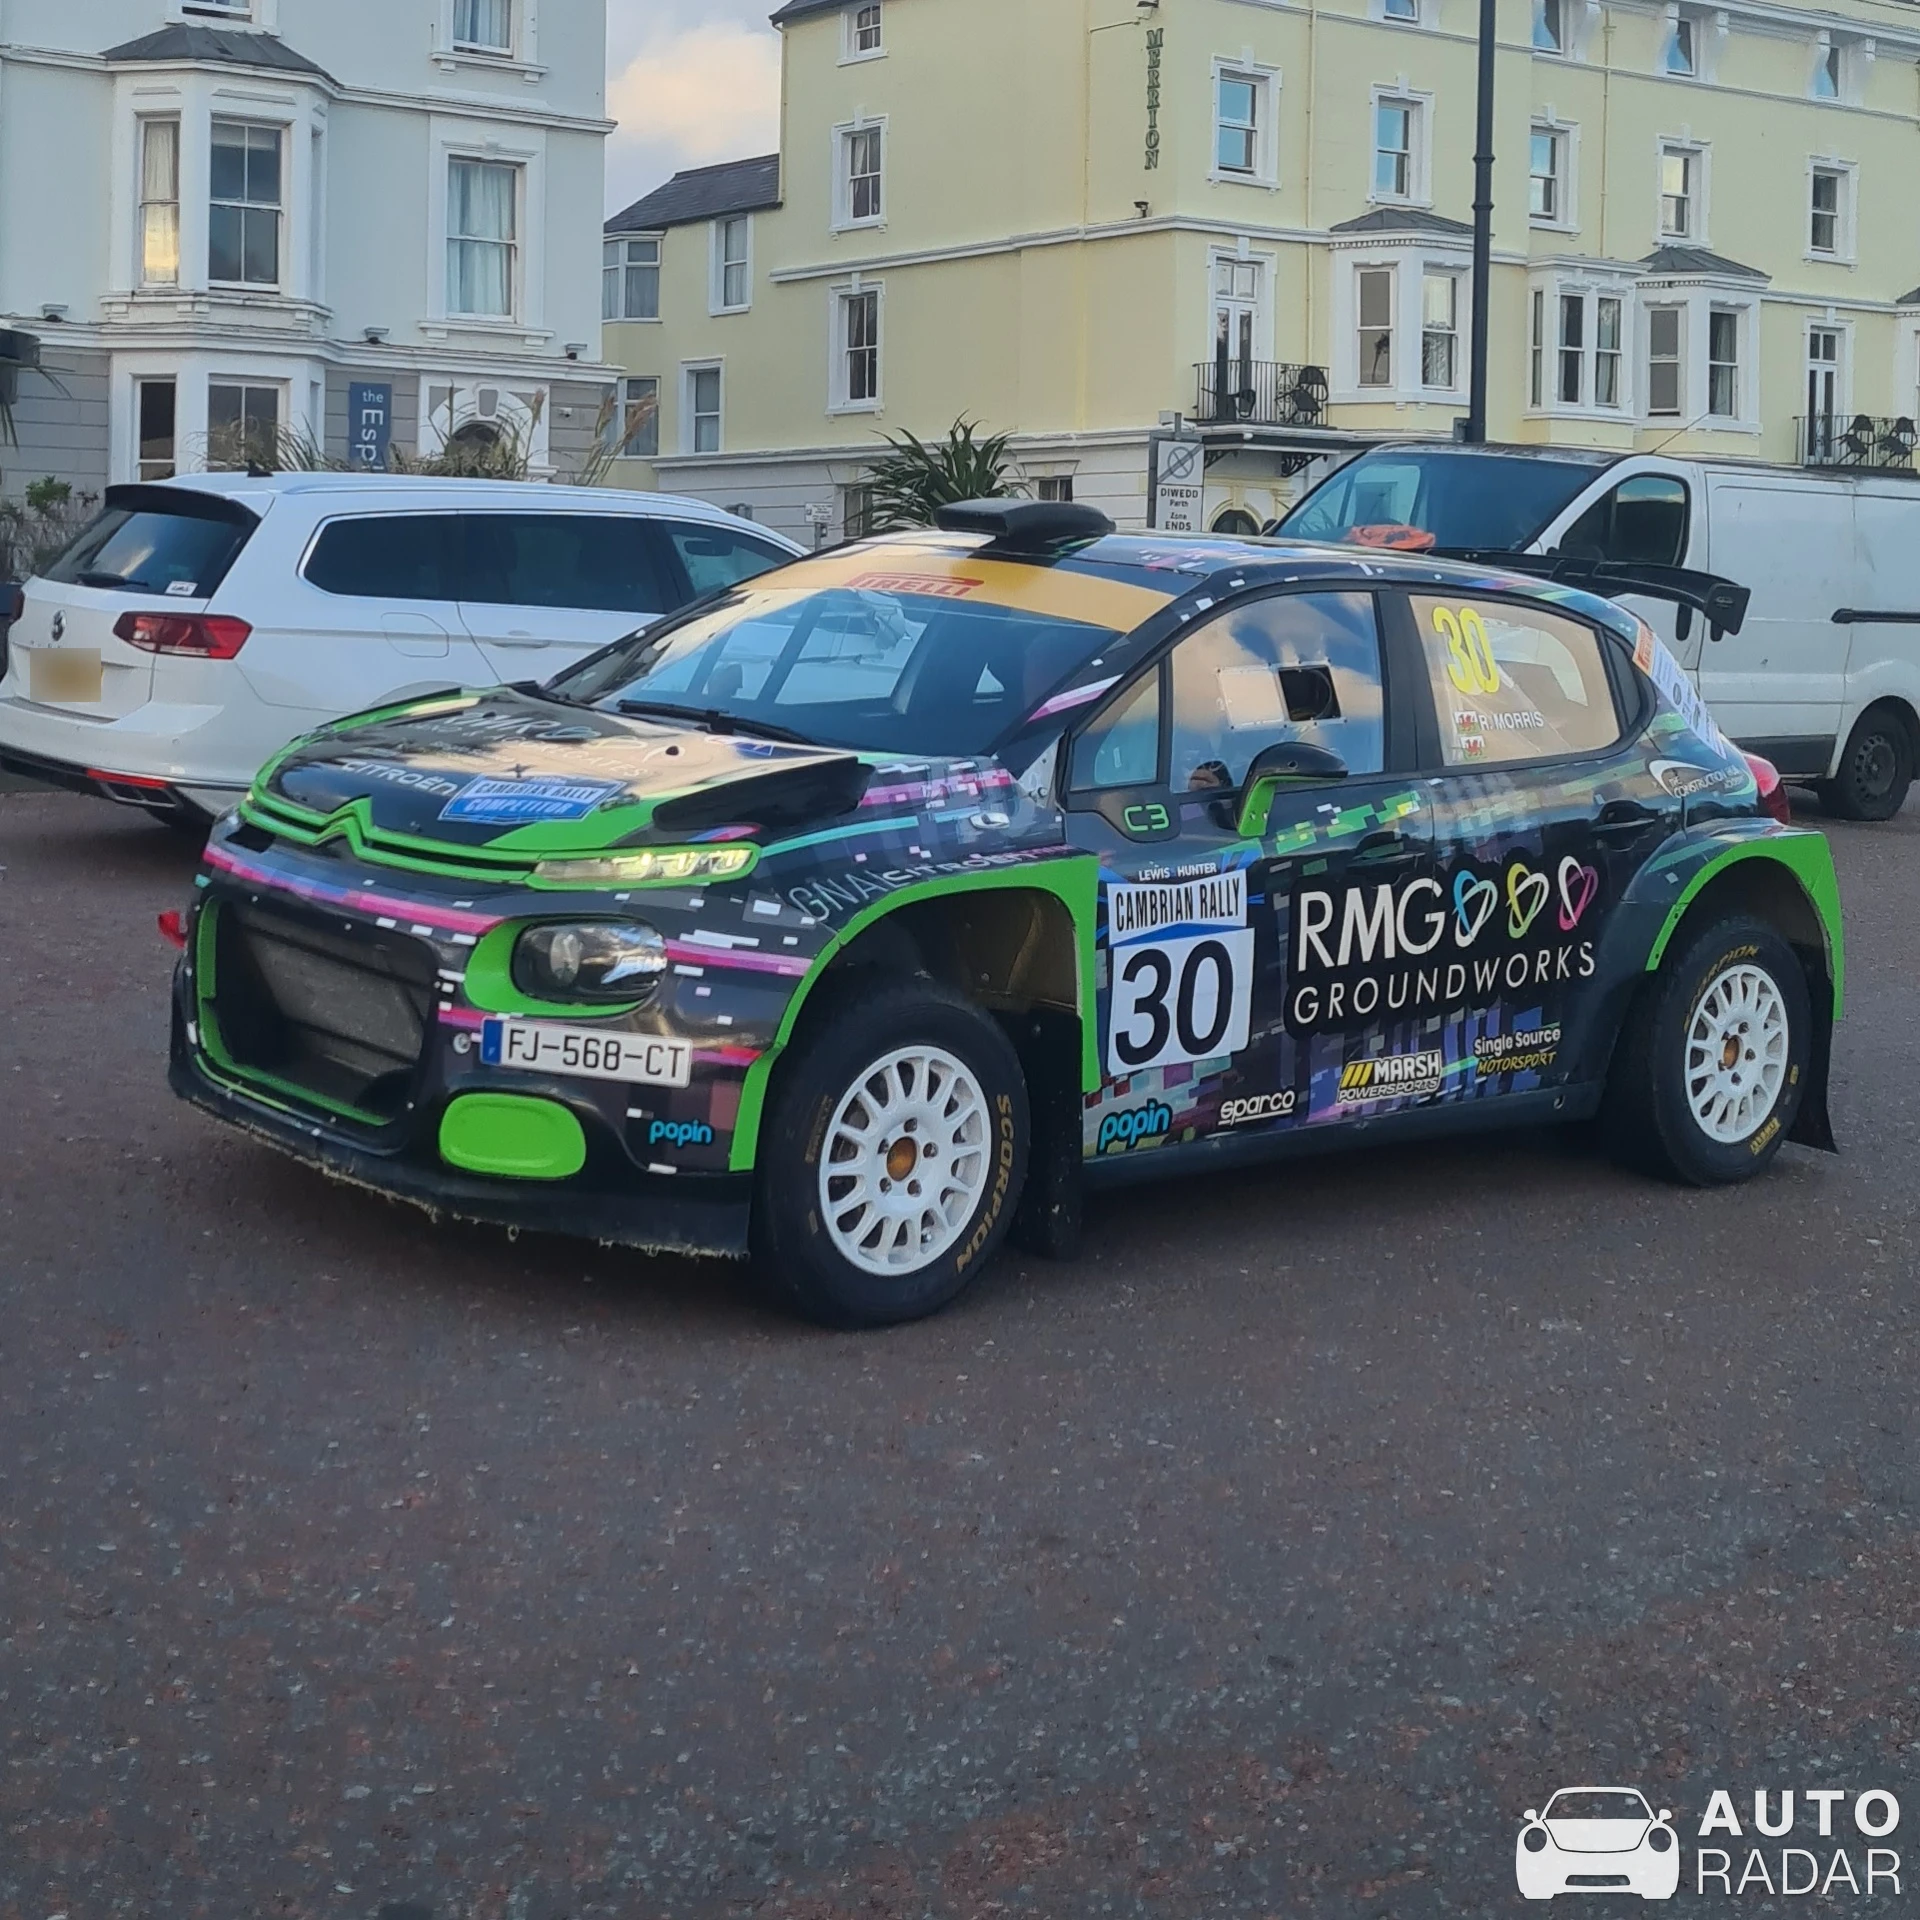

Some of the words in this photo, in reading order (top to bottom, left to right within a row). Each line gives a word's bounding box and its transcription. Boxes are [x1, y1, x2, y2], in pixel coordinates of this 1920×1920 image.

[1144, 27, 1164, 170] MERRION
[362, 389, 384, 403] the
[1160, 487, 1199, 498] DIWEDD
[1165, 520, 1192, 531] ENDS
[1170, 511, 1188, 520] Zone
[1432, 606, 1500, 695] 30
[1494, 710, 1545, 730] MORRIS
[475, 780, 553, 797] CAMBRIAN
[550, 786, 600, 800] RALLY
[463, 798, 575, 814] COMPETITOR
[1124, 803, 1170, 831] C3
[1138, 866, 1171, 882] LEWIS
[1177, 862, 1218, 878] HUNTER
[1115, 886, 1194, 932] CAMBRIAN
[1199, 877, 1240, 919] RALLY
[1298, 877, 1446, 972] RMG
[1294, 941, 1596, 1024] GROUNDWORKS
[1115, 940, 1234, 1066] 30
[508, 1028, 686, 1079] FJ-568-CT
[1474, 1035, 1514, 1058] Single
[1515, 1027, 1562, 1049] Source
[1373, 1052, 1441, 1084] MARSH
[1477, 1051, 1557, 1076] MOTORSPORT
[1338, 1078, 1439, 1102] POWERSPORTS
[1219, 1090, 1295, 1127] sparco
[650, 1119, 712, 1147] popin
[1099, 1102, 1170, 1151] popin
